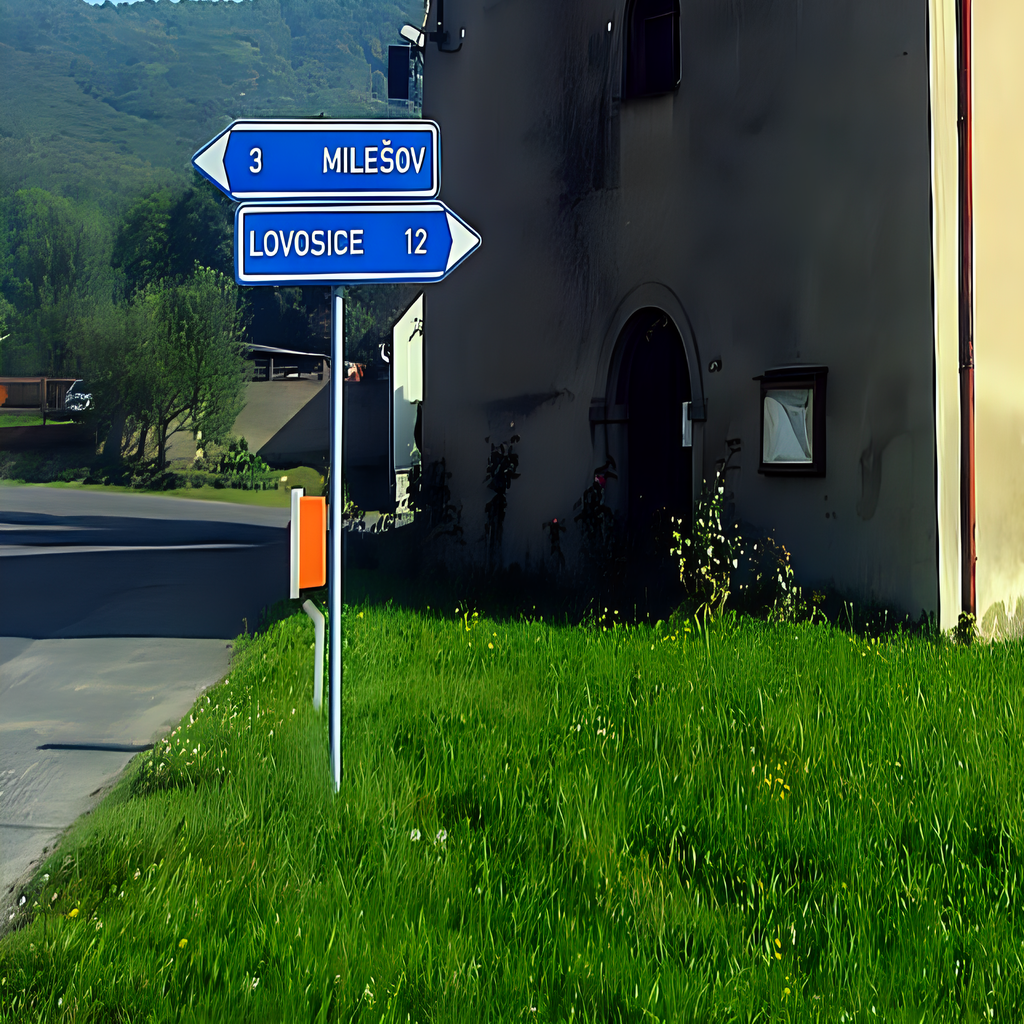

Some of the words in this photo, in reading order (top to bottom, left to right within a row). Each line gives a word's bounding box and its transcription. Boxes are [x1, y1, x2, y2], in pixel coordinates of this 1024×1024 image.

[249, 147, 262, 174] 3
[323, 139, 426, 174] MILEŠOV
[249, 229, 364, 257] LOVOSICE
[405, 228, 427, 255] 12
